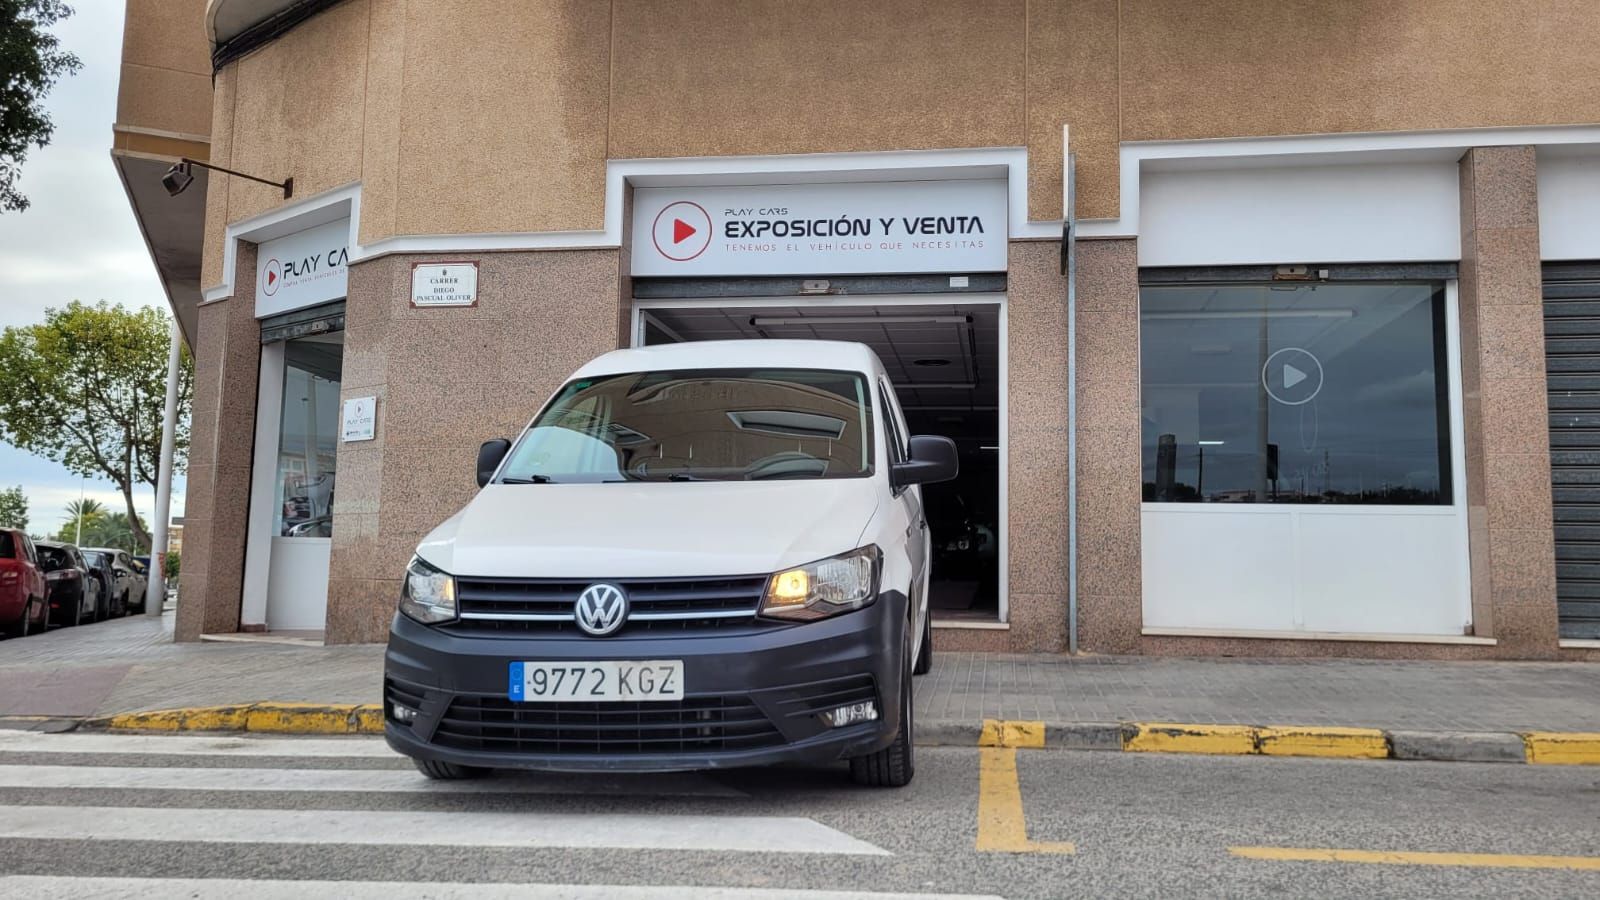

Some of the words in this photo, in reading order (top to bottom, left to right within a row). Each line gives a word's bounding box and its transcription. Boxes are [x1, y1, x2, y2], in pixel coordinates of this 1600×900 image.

[725, 208, 753, 216] PLAY
[759, 207, 788, 216] CARS
[725, 215, 871, 238] EXPOSICIÓN
[878, 218, 895, 236] Y
[902, 216, 984, 235] VENTA
[726, 244, 777, 252] TENEMOS
[880, 242, 903, 250] QUE
[912, 240, 984, 249] NECESITAS
[283, 254, 321, 279] PLAY
[327, 247, 350, 267] CA
[513, 685, 520, 693] E
[532, 668, 605, 696] 9772
[618, 666, 675, 695] KGZ
